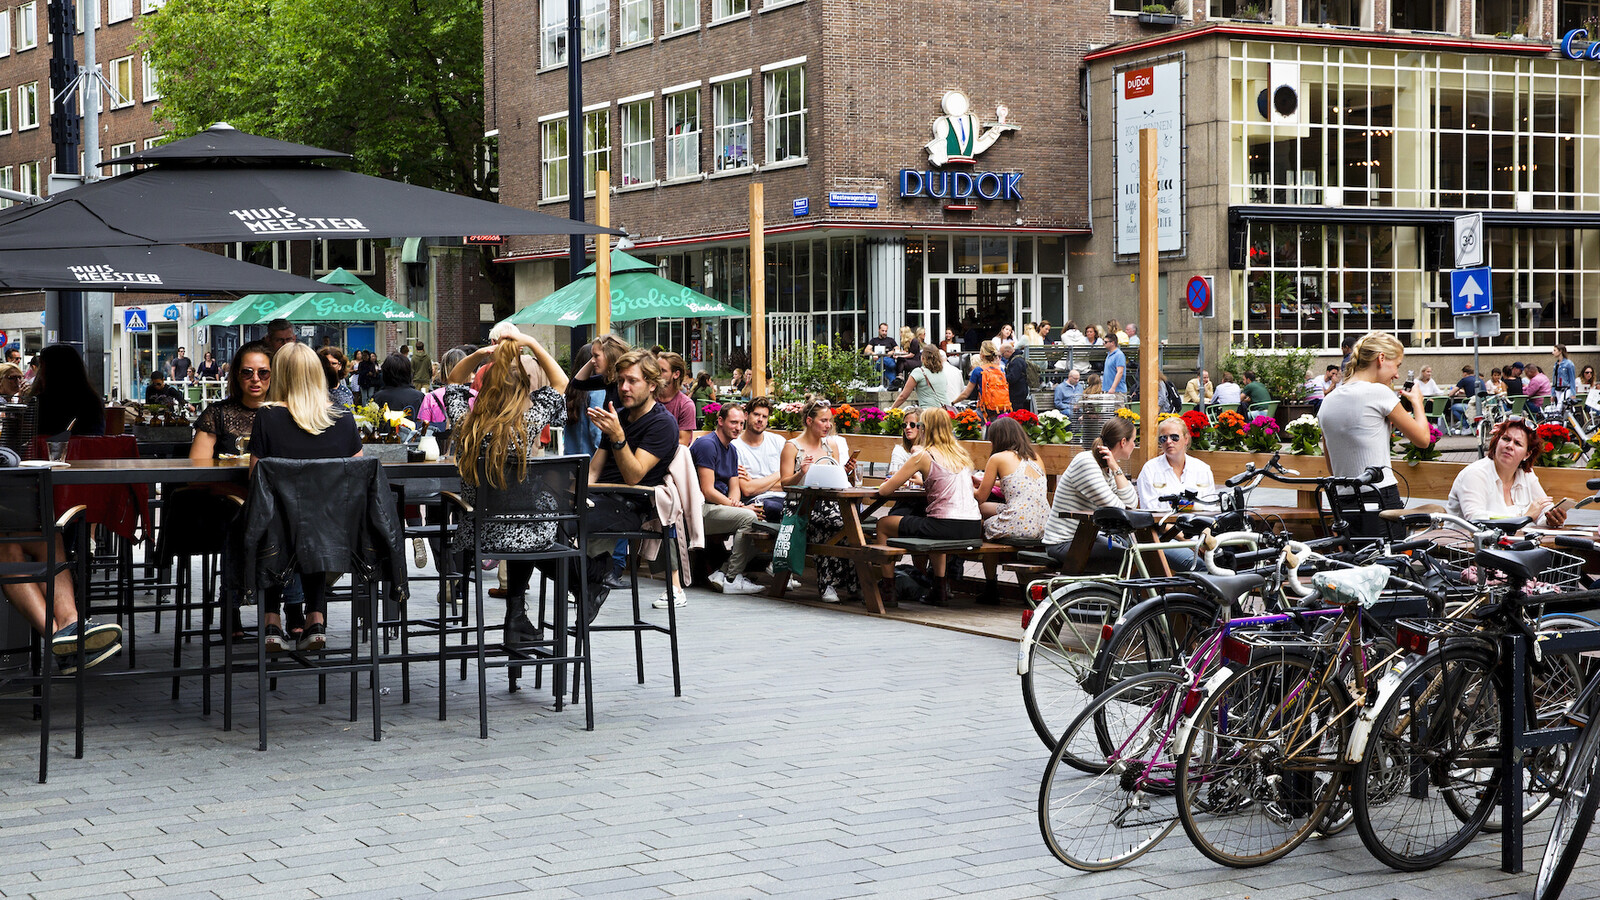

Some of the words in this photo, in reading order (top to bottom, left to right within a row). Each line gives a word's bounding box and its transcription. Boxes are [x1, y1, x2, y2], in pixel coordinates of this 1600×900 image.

[1127, 76, 1151, 89] DUDOK
[900, 169, 1024, 200] DUDOK
[229, 206, 296, 220] HUIS
[244, 217, 367, 232] MEESTER
[67, 264, 114, 273] HUIS
[74, 272, 162, 283] MEESTER
[310, 297, 394, 317] Grolsch
[610, 287, 699, 316] Grolsch
[686, 302, 726, 313] Grolsch
[383, 311, 415, 319] Grolsch
